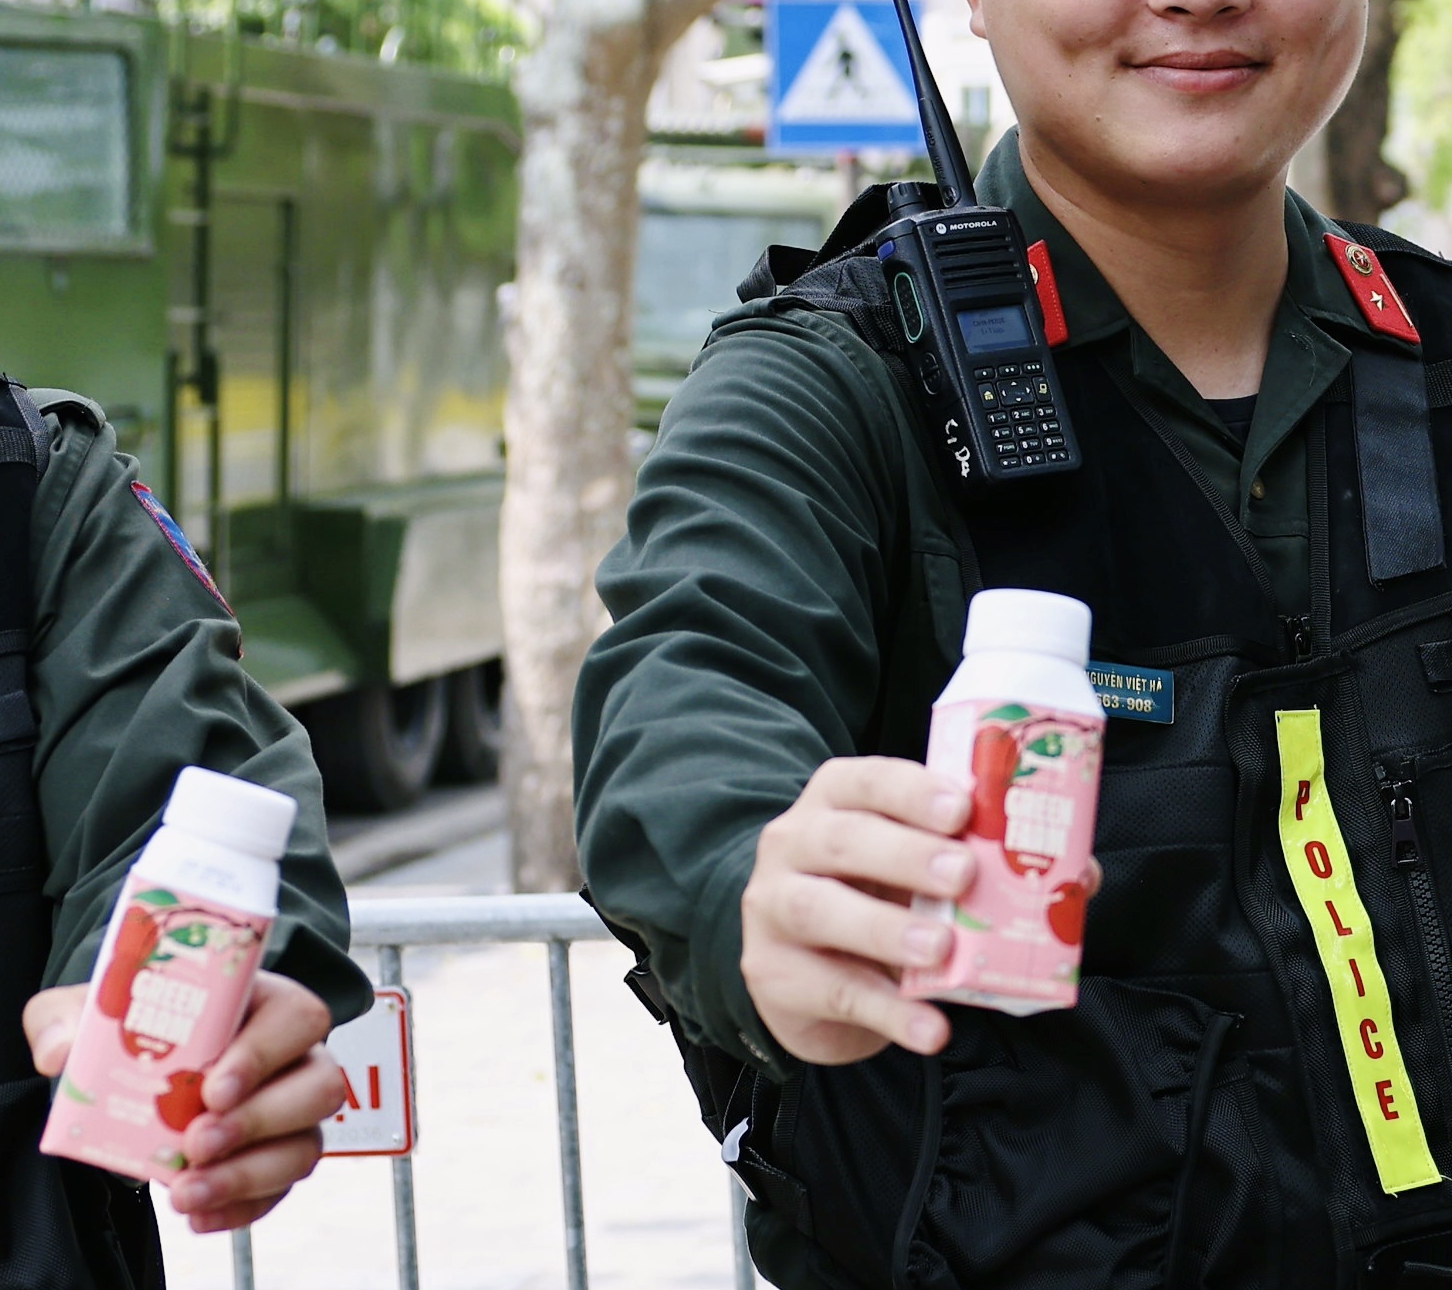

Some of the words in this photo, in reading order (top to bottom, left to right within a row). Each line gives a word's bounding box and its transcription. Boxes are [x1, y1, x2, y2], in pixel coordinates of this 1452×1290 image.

[950, 220, 997, 230] MOTOROLA
[1014, 411, 1020, 419] 2
[1126, 674, 1147, 695] VIỆT
[1295, 780, 1399, 1121] POLICE
